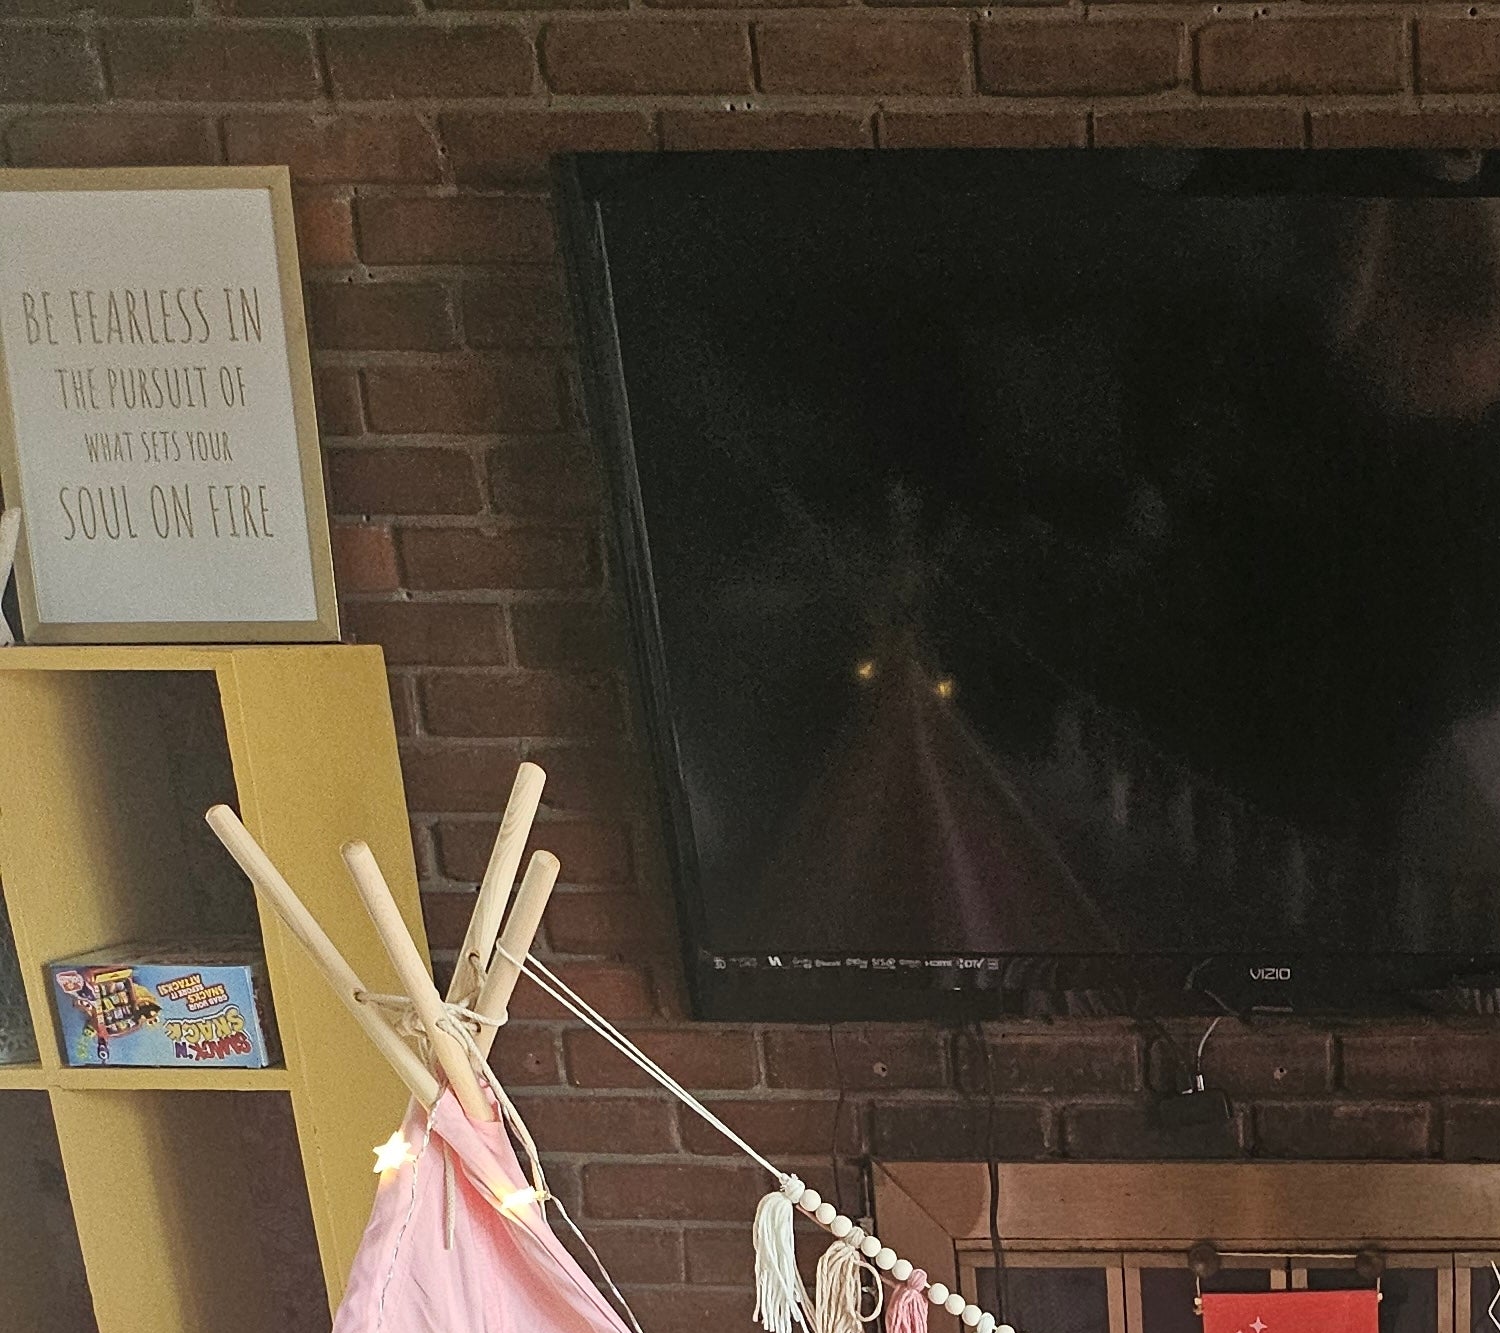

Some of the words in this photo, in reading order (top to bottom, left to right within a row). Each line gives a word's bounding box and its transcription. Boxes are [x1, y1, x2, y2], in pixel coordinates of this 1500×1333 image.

[22, 290, 58, 345] BE
[69, 287, 211, 345] FEARLESS
[223, 287, 262, 343] IN
[54, 367, 100, 410] THE
[107, 366, 208, 409] PURSUIT
[219, 365, 247, 407] OF
[84, 432, 134, 463] WHAT
[141, 431, 181, 463] SETS
[186, 431, 233, 462] YOUR
[59, 485, 138, 541] SOUL
[150, 483, 195, 539] ON
[207, 484, 275, 539] FIRE
[157, 974, 201, 996] ATTACKS!
[1249, 967, 1291, 980] VIZIO
[187, 985, 225, 1003] SNACKS
[164, 1008, 245, 1043] SNACK
